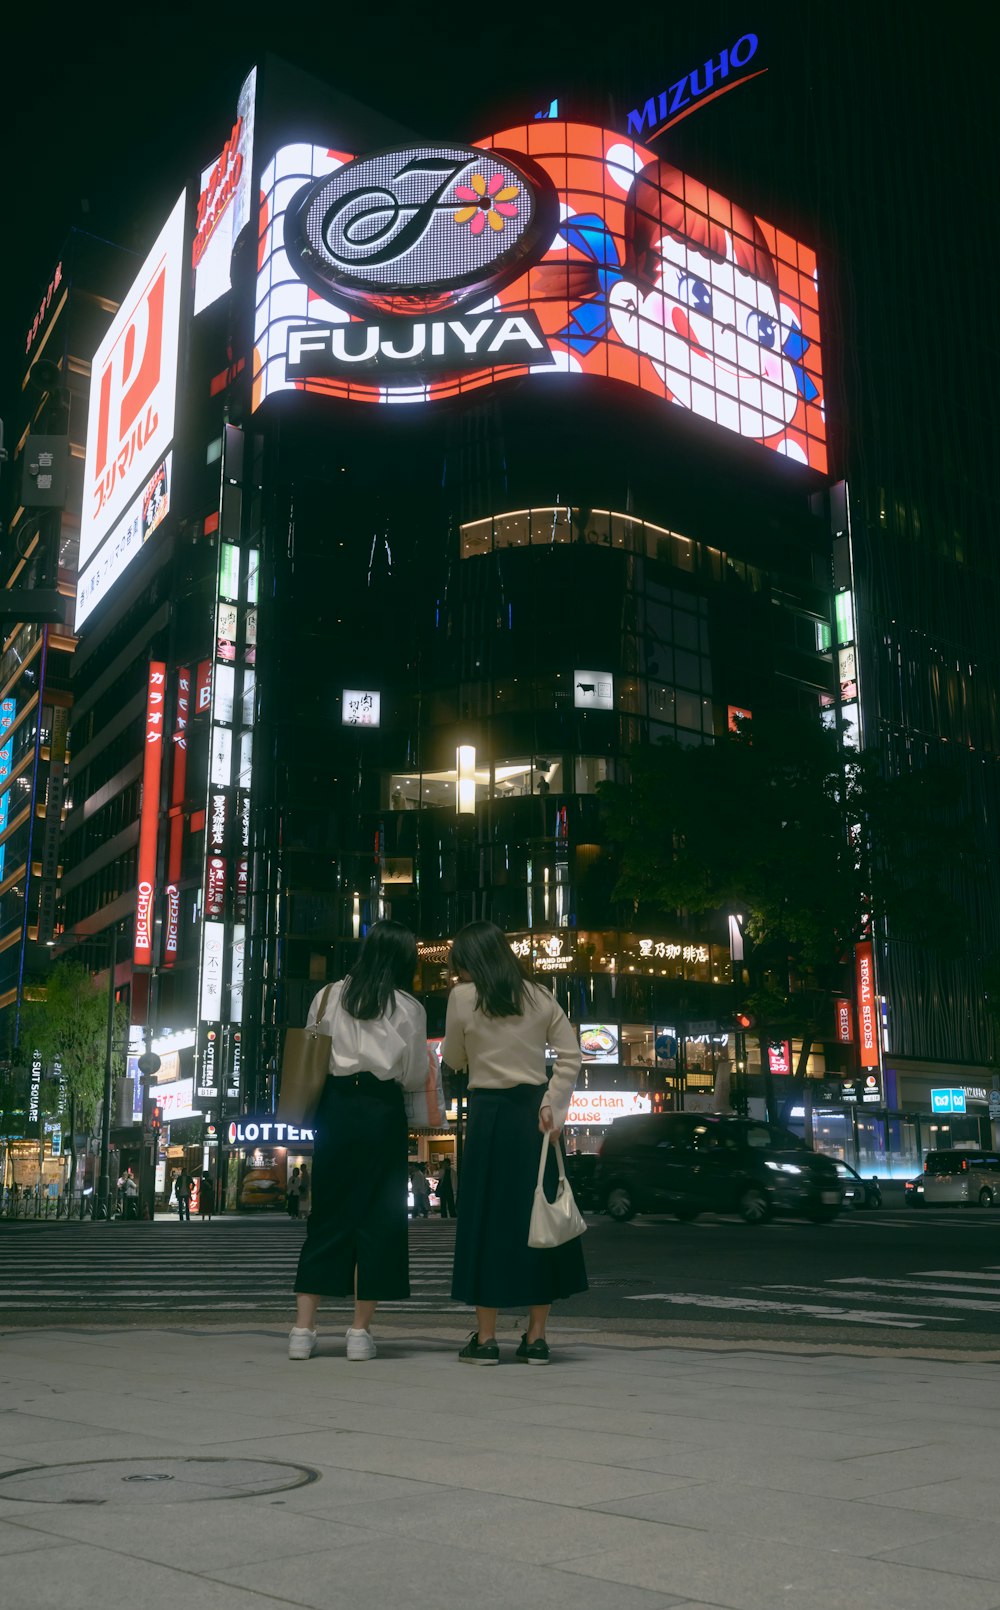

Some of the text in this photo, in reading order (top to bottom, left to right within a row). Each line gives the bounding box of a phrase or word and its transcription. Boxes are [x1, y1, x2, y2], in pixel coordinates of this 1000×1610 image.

[626, 33, 759, 135] MIZUHO
[288, 317, 544, 364] FUJIYA
[93, 409, 159, 520] プリマハム
[147, 672, 164, 742] カラオケ
[212, 795, 226, 845] 星乃珈琲店
[215, 869, 224, 903] 不二家
[136, 881, 152, 948] BIG ECHO
[207, 956, 218, 995] 不二家
[537, 957, 556, 965] HAND
[639, 939, 709, 964] 星乃珈琲店
[860, 958, 873, 1049] REGAL SHOES
[206, 1041, 214, 1087] LOTTERIA
[28, 1061, 41, 1123] SUIT SQUARE
[569, 1095, 624, 1108] ko chan
